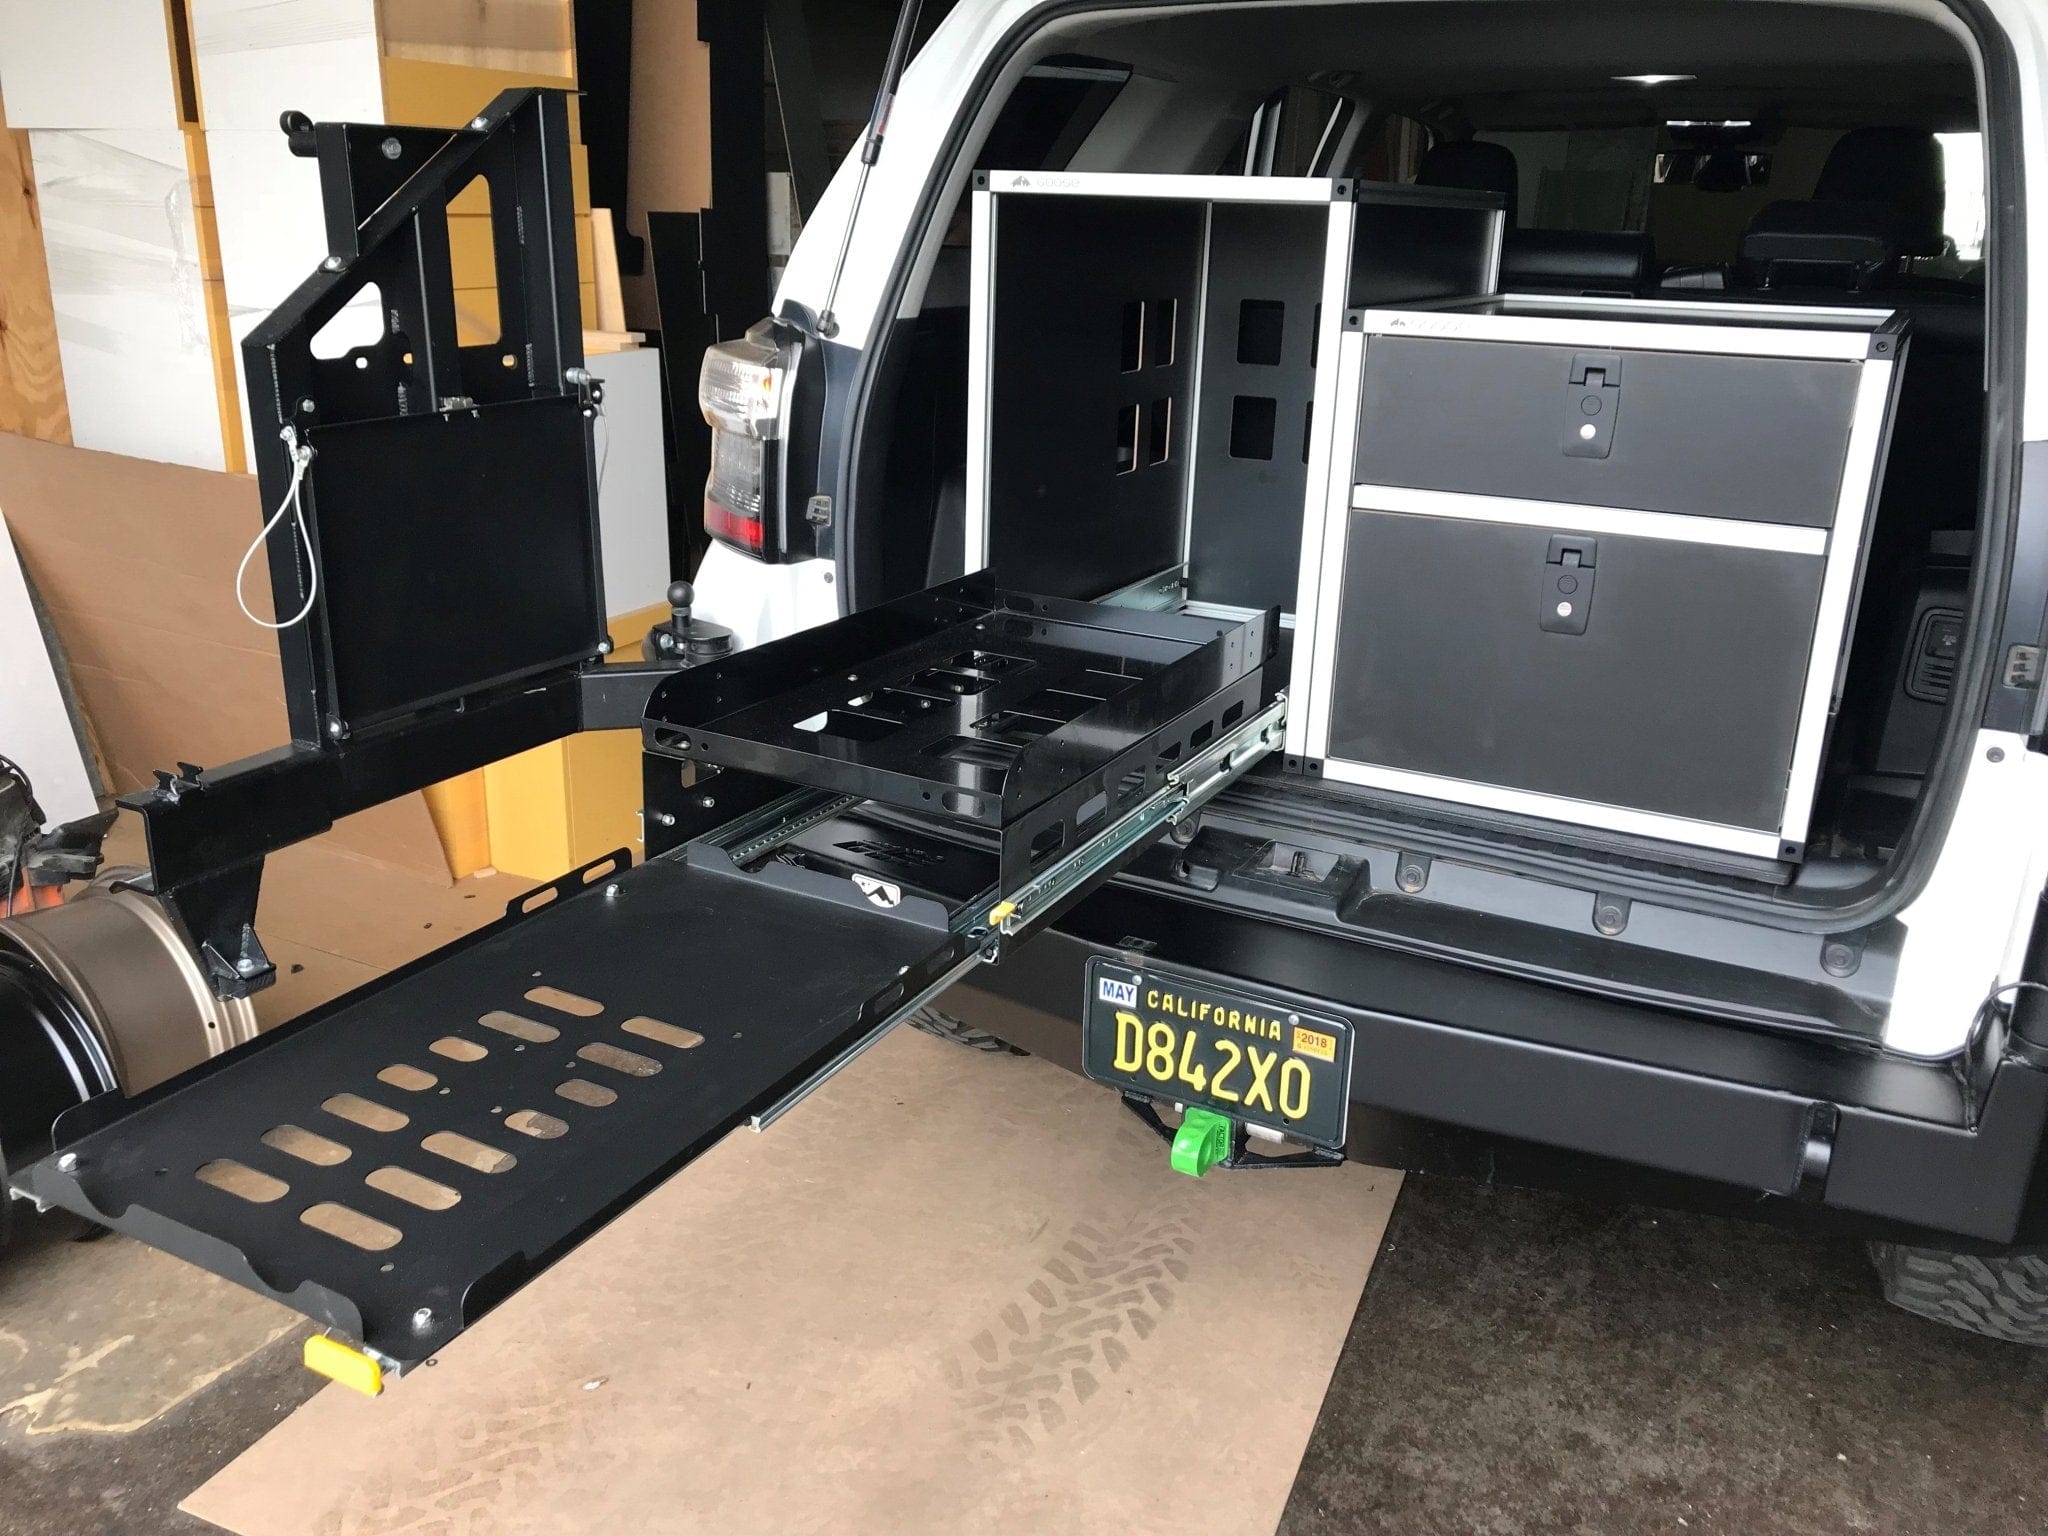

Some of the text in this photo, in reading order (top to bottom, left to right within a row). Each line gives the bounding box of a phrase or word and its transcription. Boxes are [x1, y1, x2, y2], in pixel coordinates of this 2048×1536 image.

[1102, 981, 1135, 1001] MAY
[1147, 990, 1282, 1041] CALIFORNIA
[1301, 1033, 1327, 1048] 2018
